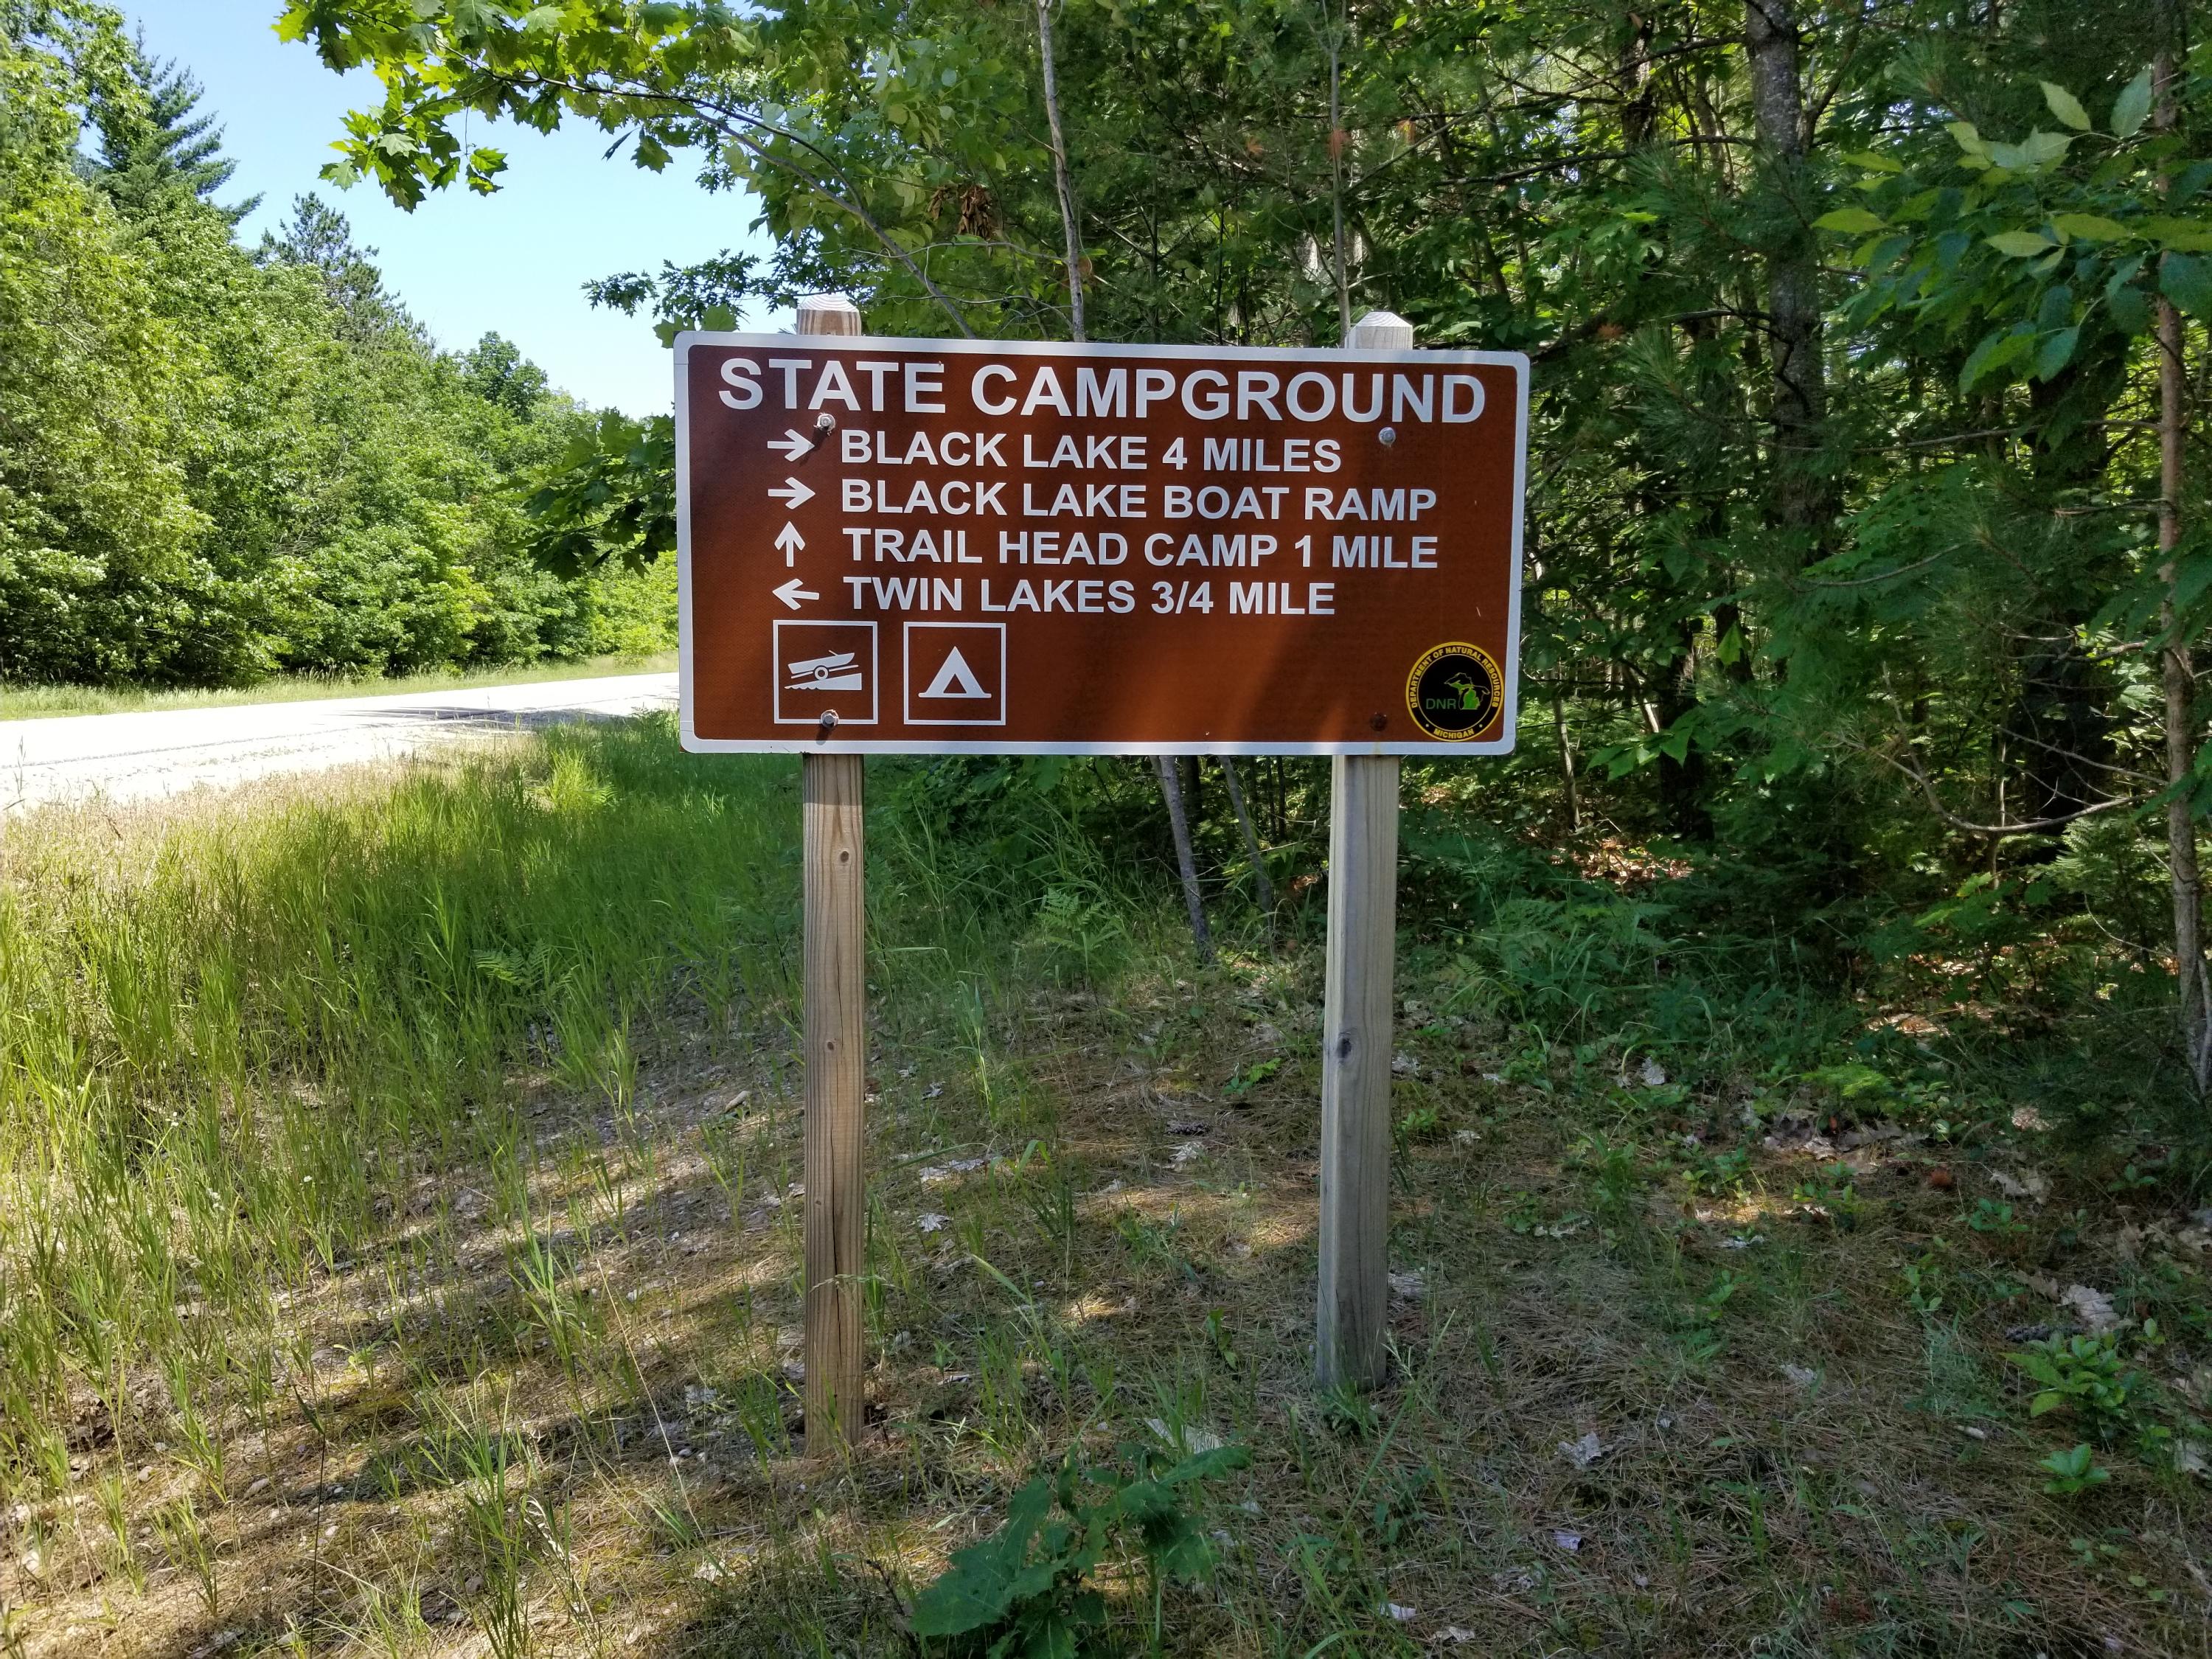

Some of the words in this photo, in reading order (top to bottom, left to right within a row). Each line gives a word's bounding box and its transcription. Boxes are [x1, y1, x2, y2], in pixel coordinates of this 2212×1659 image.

[719, 358, 945, 413] STATE
[972, 365, 1485, 422] CAMPGROUND
[842, 430, 1007, 466] BLACK
[1024, 434, 1147, 469] LAKE
[1163, 437, 1186, 470] 4
[1204, 438, 1340, 473] MILES
[842, 479, 1007, 515] BLACK
[1023, 484, 1146, 518] LAKE
[1164, 486, 1289, 519] BOAT
[1305, 488, 1436, 521] RAMP
[843, 528, 982, 563] TRAIL
[1000, 531, 1127, 565] HEAD
[1144, 533, 1277, 566] CAMP
[1295, 535, 1310, 567] 1
[1332, 536, 1437, 568] MILE
[844, 577, 961, 611] TWIN
[981, 580, 1135, 613] LAKES
[1152, 581, 1213, 613] 3/4
[1230, 582, 1335, 614] MILE
[1409, 655, 1433, 709] DEPARTMENT
[1433, 649, 1444, 658] OF
[1445, 647, 1481, 661] NATURAL
[1481, 658, 1501, 708] RESOURCES
[1426, 698, 1457, 709] DNR
[1433, 728, 1475, 739] MICHIGAN
